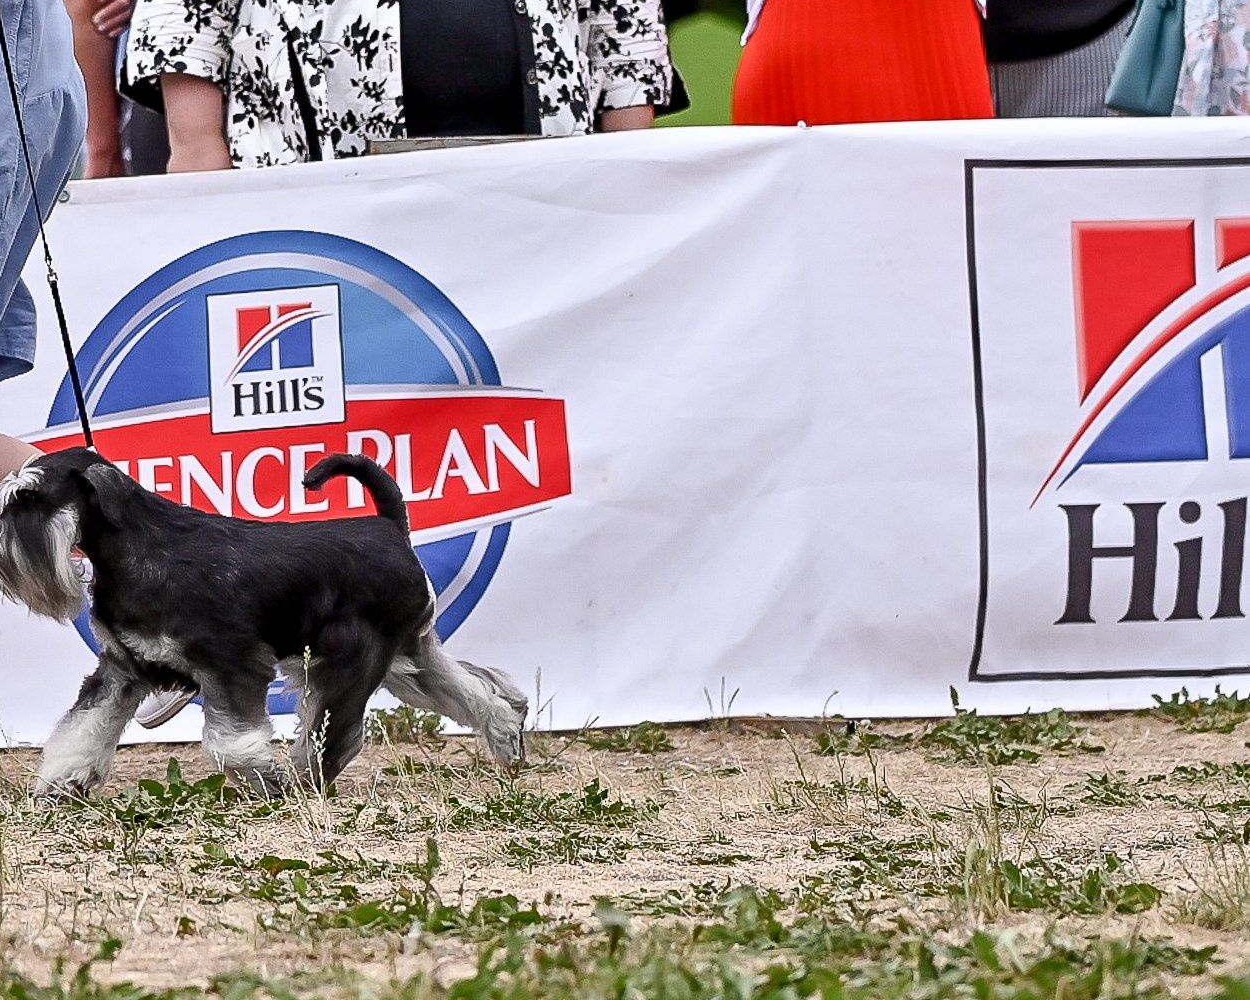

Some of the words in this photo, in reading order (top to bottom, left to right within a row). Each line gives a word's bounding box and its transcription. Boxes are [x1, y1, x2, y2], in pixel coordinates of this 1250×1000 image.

[232, 377, 325, 417] Hill's
[112, 443, 329, 519] ENCE
[346, 418, 541, 509] PLAN
[1053, 496, 1249, 626] Hil
